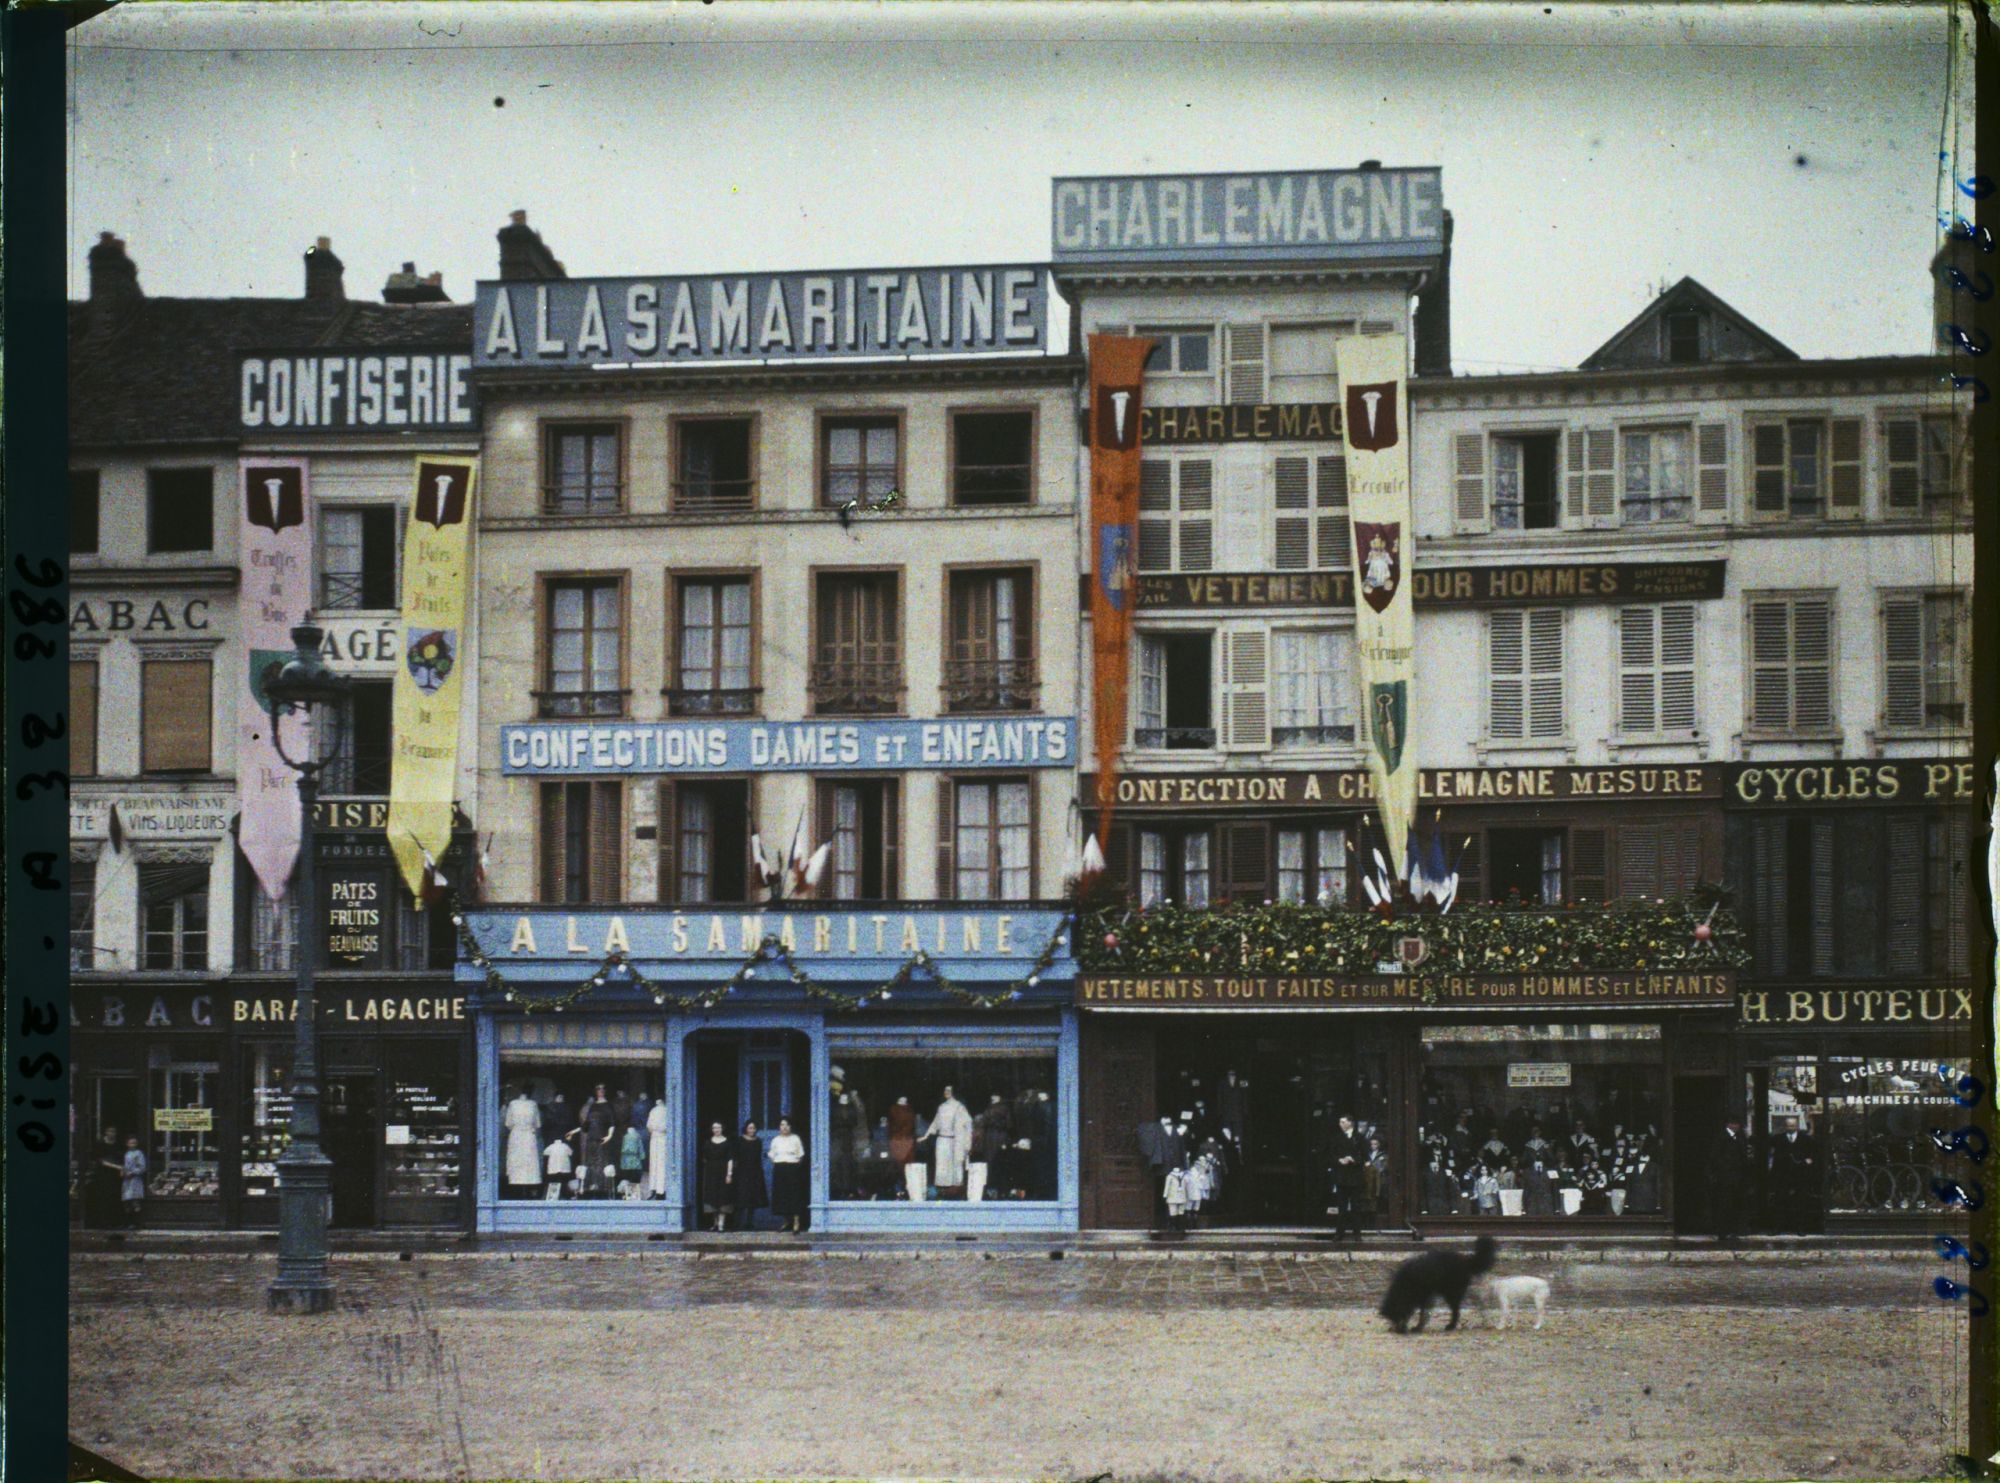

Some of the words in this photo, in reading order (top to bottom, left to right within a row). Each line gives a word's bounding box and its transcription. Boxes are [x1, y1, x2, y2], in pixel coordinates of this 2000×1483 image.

[1054, 173, 1437, 249] CHARLEMAGNE
[486, 287, 520, 357] A
[535, 284, 610, 356] LA
[625, 270, 1038, 352] SAMARITAINE
[240, 356, 472, 426] CONFISERIE
[1489, 566, 1620, 598] HOMMES
[507, 727, 729, 768] CONFECTIONS
[750, 725, 860, 766] DAMES
[876, 737, 907, 763] ET
[922, 722, 1069, 761] ENFANTS
[1303, 774, 1322, 800] A
[1570, 768, 1703, 795] MESURE
[1735, 764, 1900, 801] CYCLES
[330, 909, 379, 926] FRUITS
[509, 914, 537, 953] A
[566, 913, 631, 954] LA
[672, 912, 1014, 954] SAMARITAINE
[1084, 979, 1204, 999] VETEMENTS
[1214, 978, 1268, 998] TOUT
[1277, 977, 1335, 998] FAITS
[1340, 984, 1357, 997] ET
[1362, 984, 1389, 997] SUR
[1481, 983, 1517, 996] POUR
[1522, 976, 1609, 996] HOMMES
[1613, 982, 1630, 996] ET
[1635, 974, 1728, 996] ENFANTS
[345, 997, 466, 1021] LAGACHE
[1841, 1060, 1894, 1084] CYCLES
[1847, 1096, 1910, 1105] MACHINES
[1913, 1096, 1920, 1105] A
